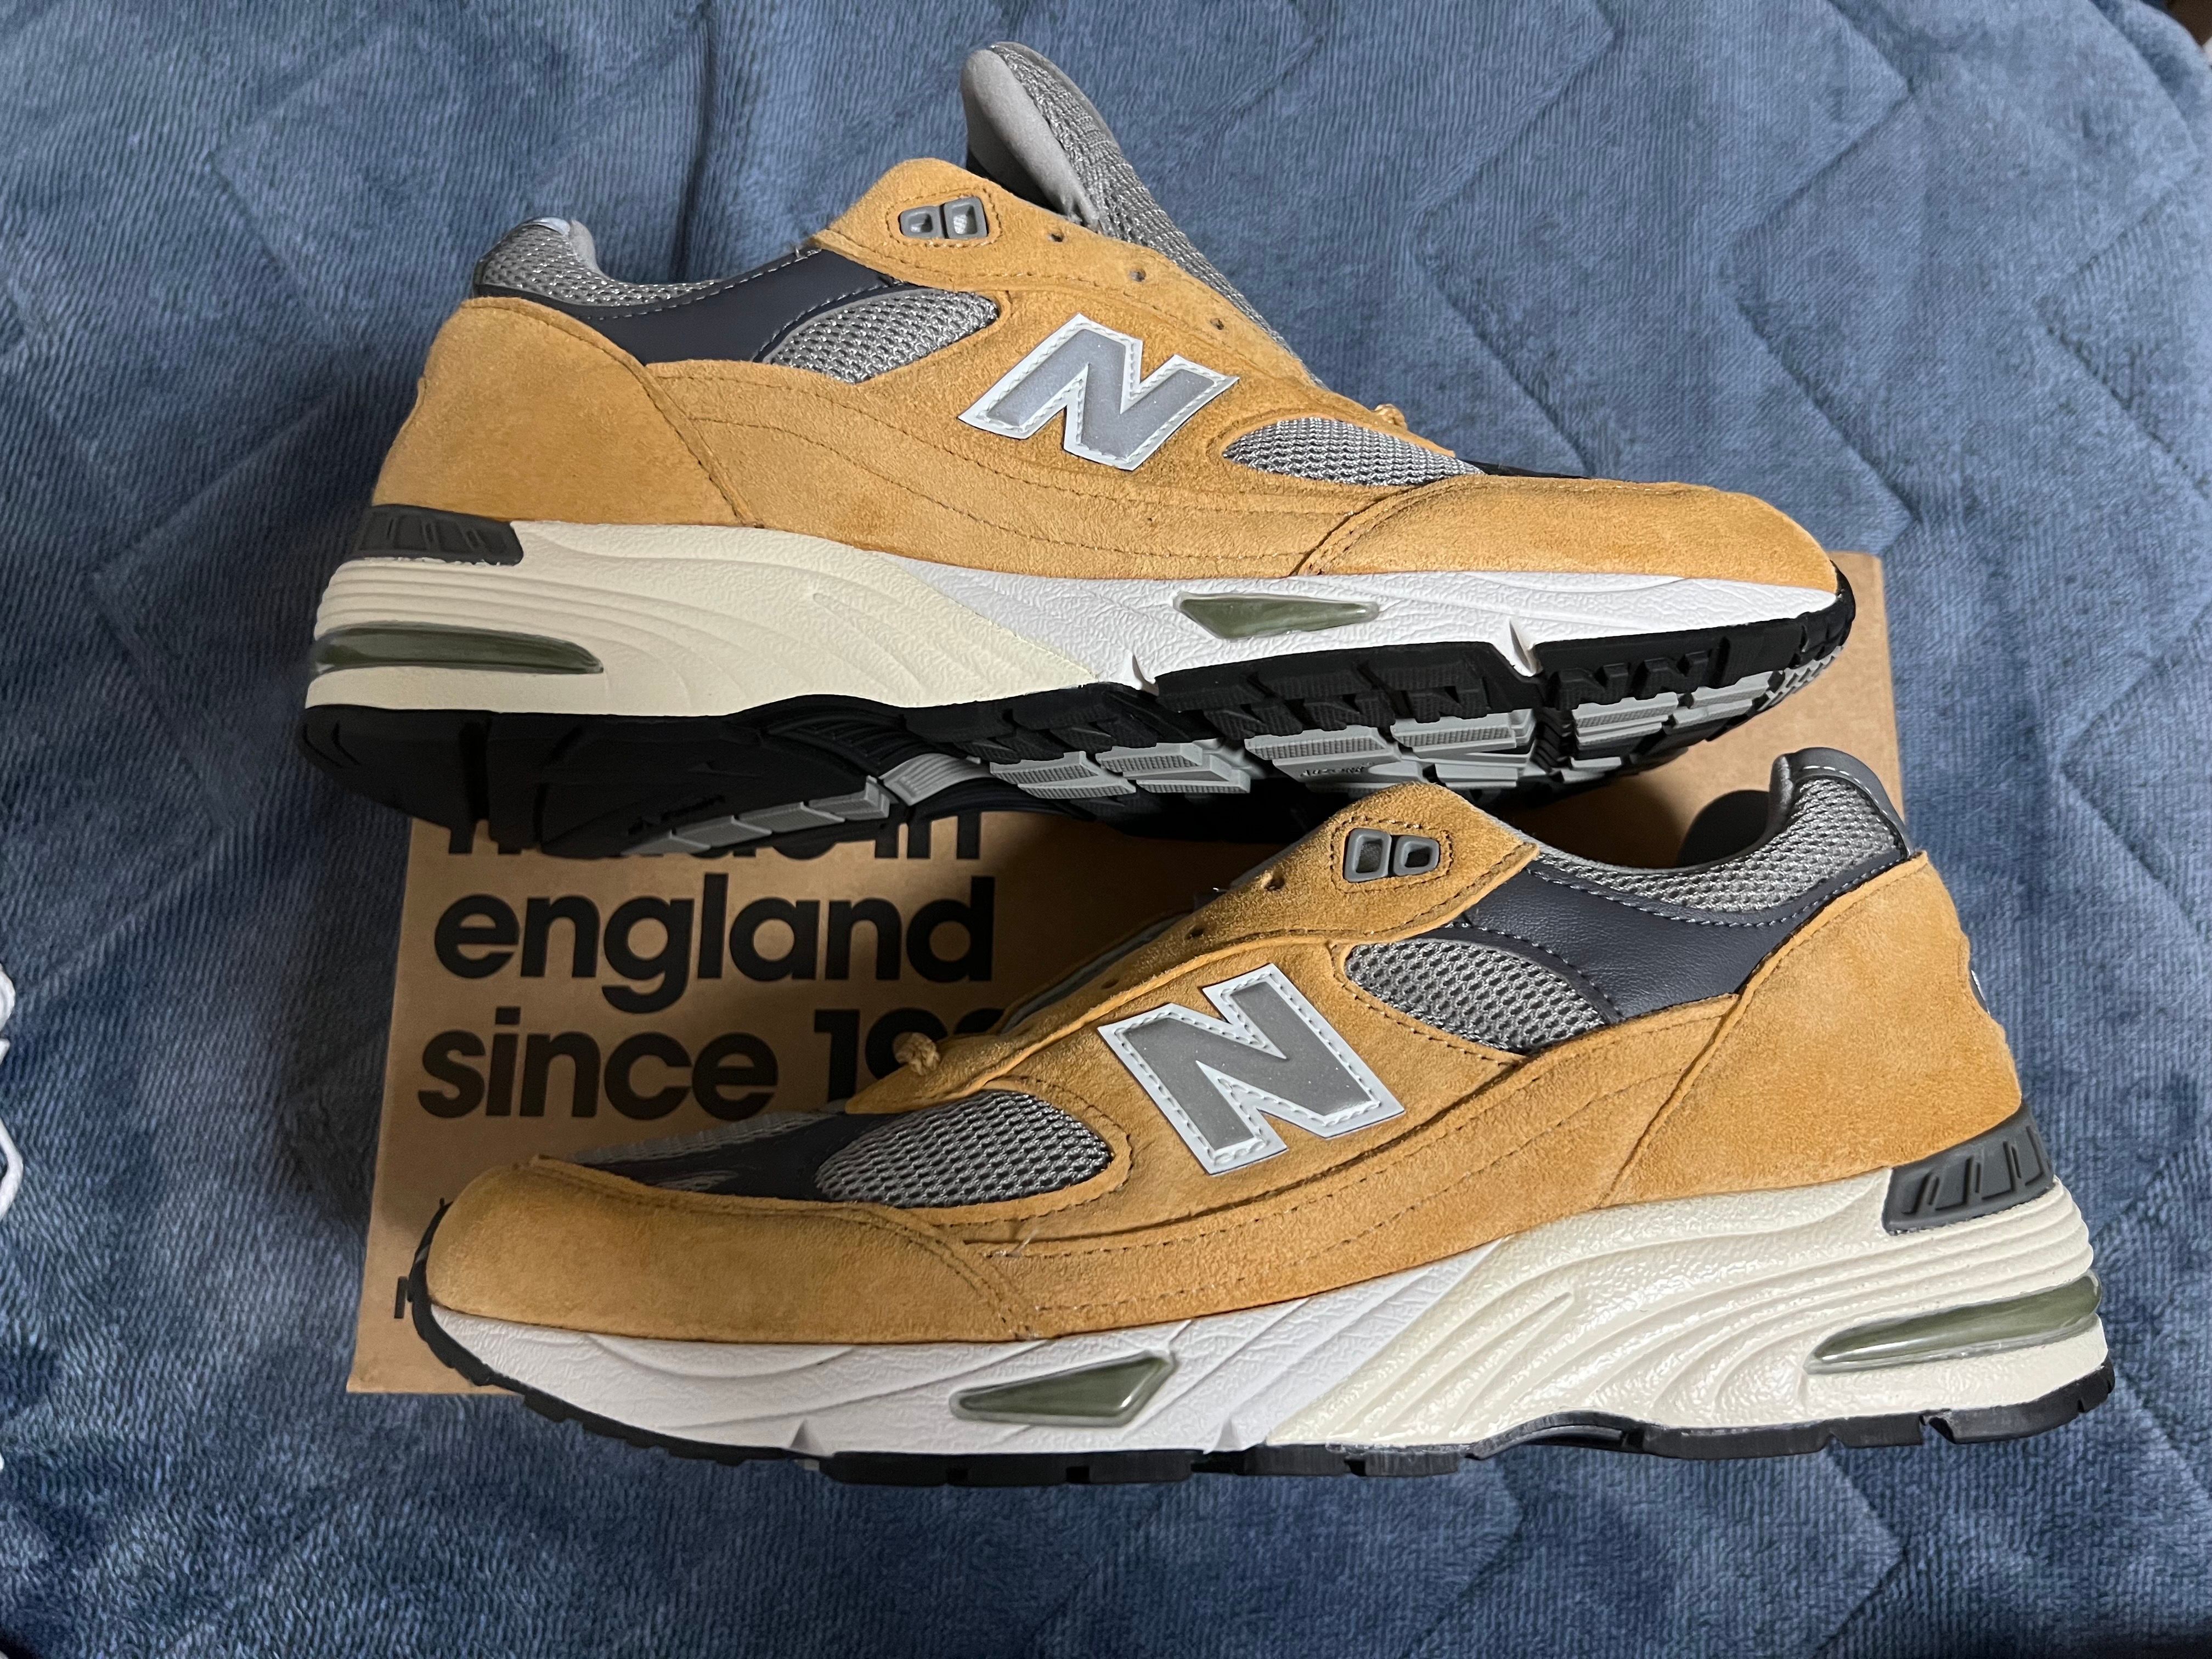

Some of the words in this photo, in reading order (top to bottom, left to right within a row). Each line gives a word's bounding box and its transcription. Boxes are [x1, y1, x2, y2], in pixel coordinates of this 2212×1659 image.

[958, 313, 1239, 471] N
[434, 873, 995, 1013] england
[418, 1006, 778, 1120] since
[1097, 963, 1404, 1175] N
